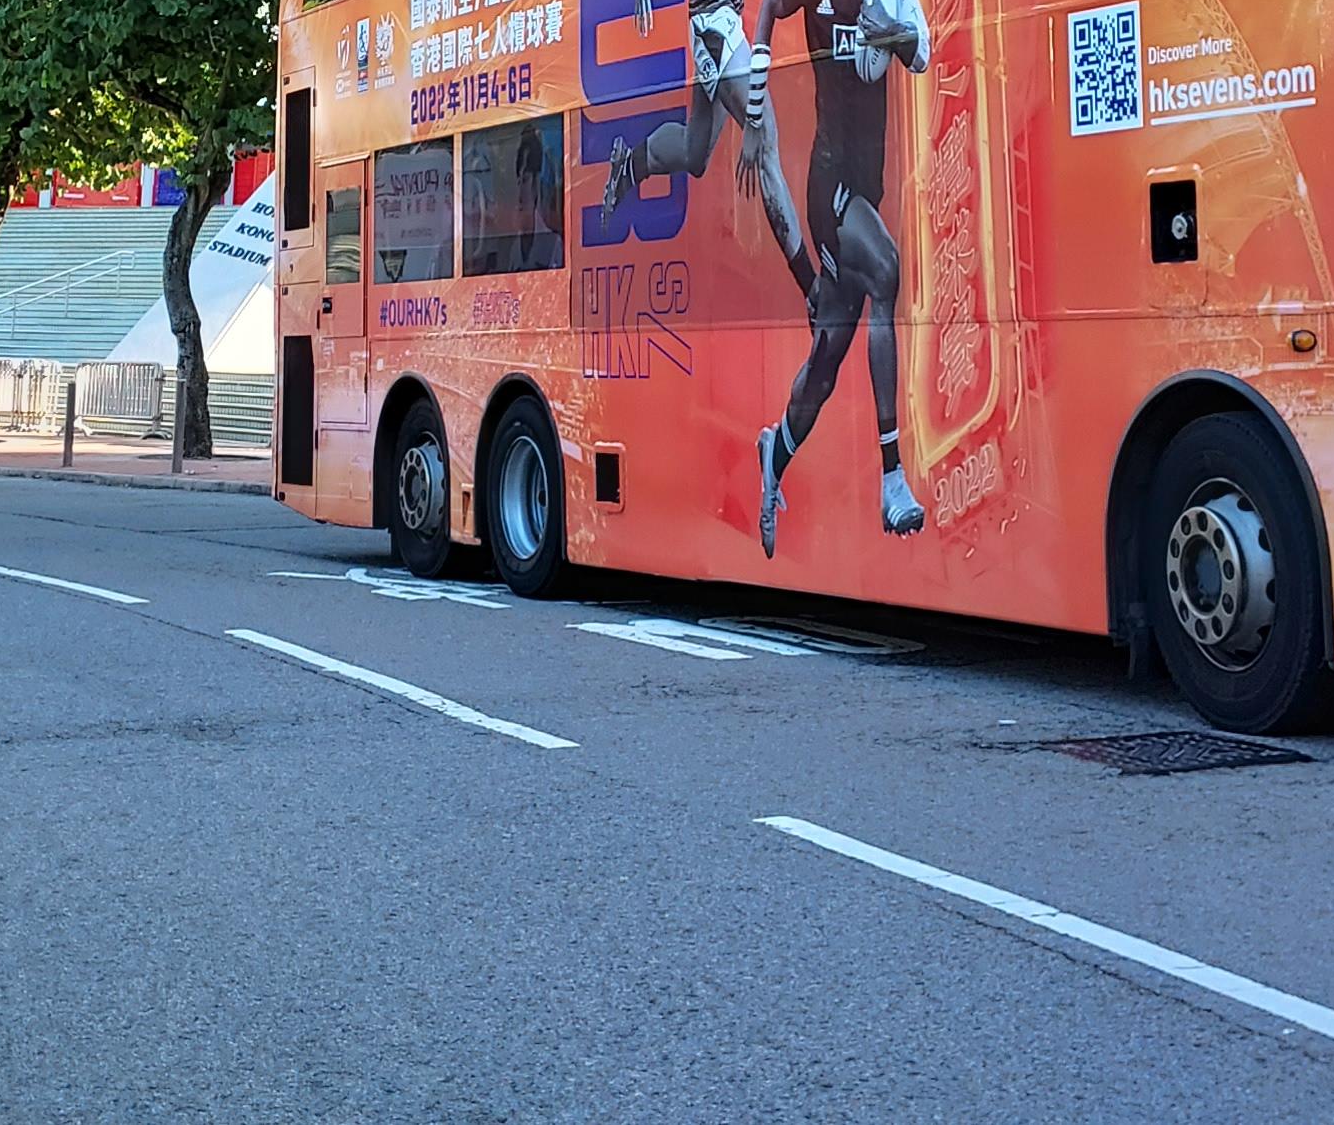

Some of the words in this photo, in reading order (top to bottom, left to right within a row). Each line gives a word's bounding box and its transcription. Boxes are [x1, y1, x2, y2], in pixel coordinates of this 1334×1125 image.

[410, 0, 564, 80] 香港國際七人欖球賽
[1148, 44, 1199, 64] Discover
[1201, 36, 1232, 55] More
[410, 62, 533, 126] 2022年11月4-6日
[1148, 64, 1316, 113] hksevens.com
[251, 202, 275, 218] HO
[208, 239, 273, 266] STADIUM
[380, 297, 448, 327] #OURHK7s
